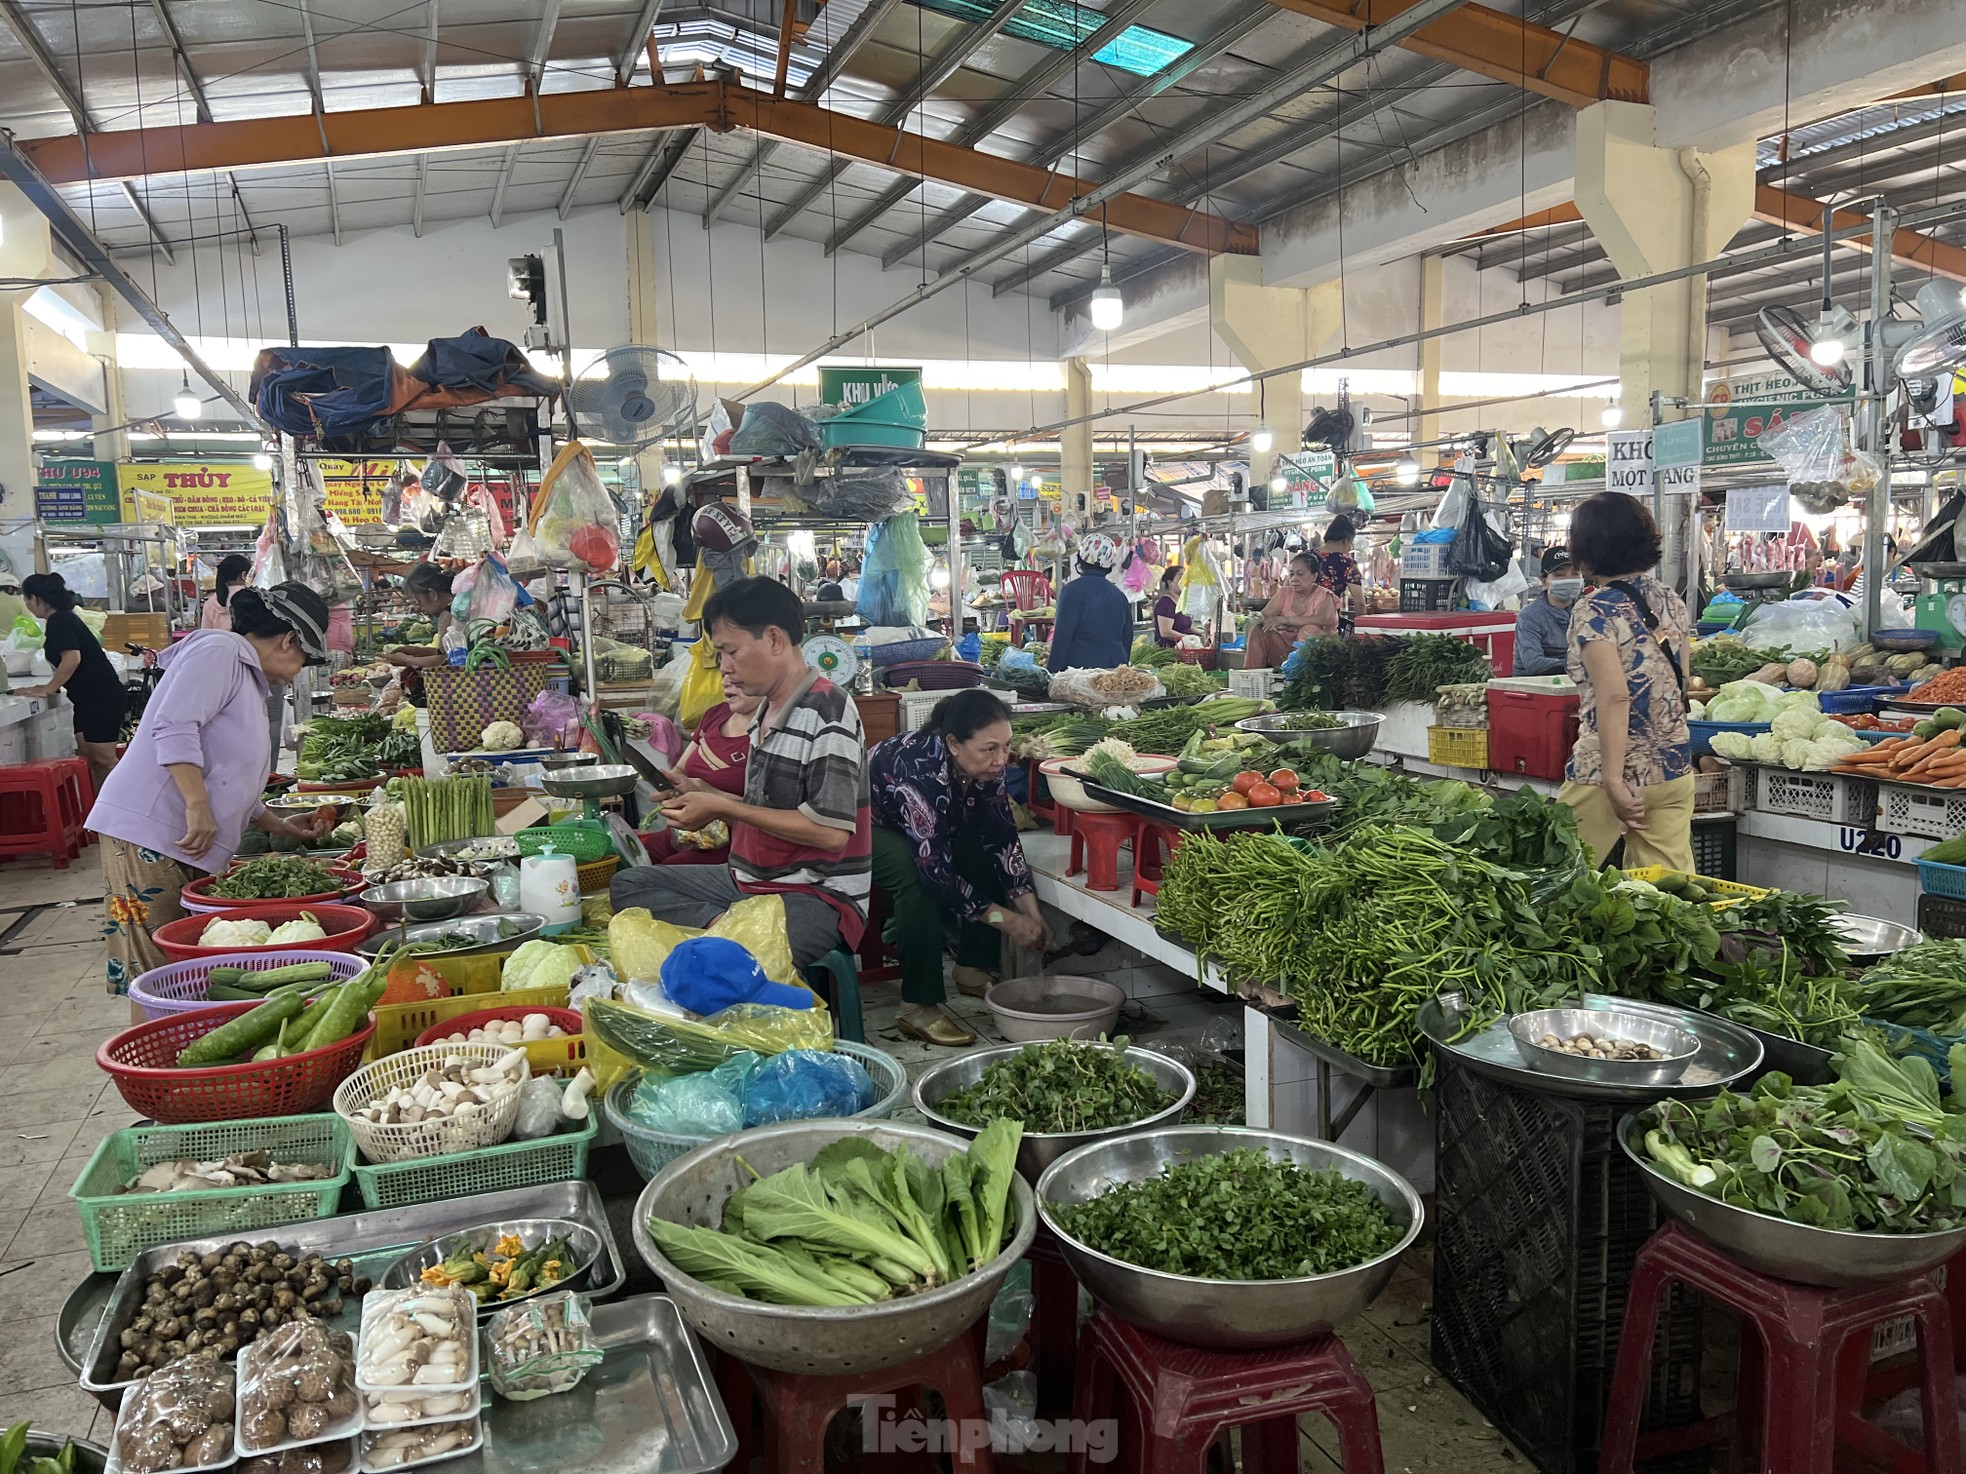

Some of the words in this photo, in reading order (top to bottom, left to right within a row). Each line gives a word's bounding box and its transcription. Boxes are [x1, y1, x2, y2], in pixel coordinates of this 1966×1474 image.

[842, 382, 870, 404] KHU
[1734, 382, 1761, 395] THỊT
[1765, 378, 1791, 390] HEO
[70, 467, 101, 479] U94
[163, 466, 232, 488] THỦY
[1612, 467, 1647, 490] MỘT
[1651, 467, 1694, 485] ANG
[188, 505, 204, 513] CHUA
